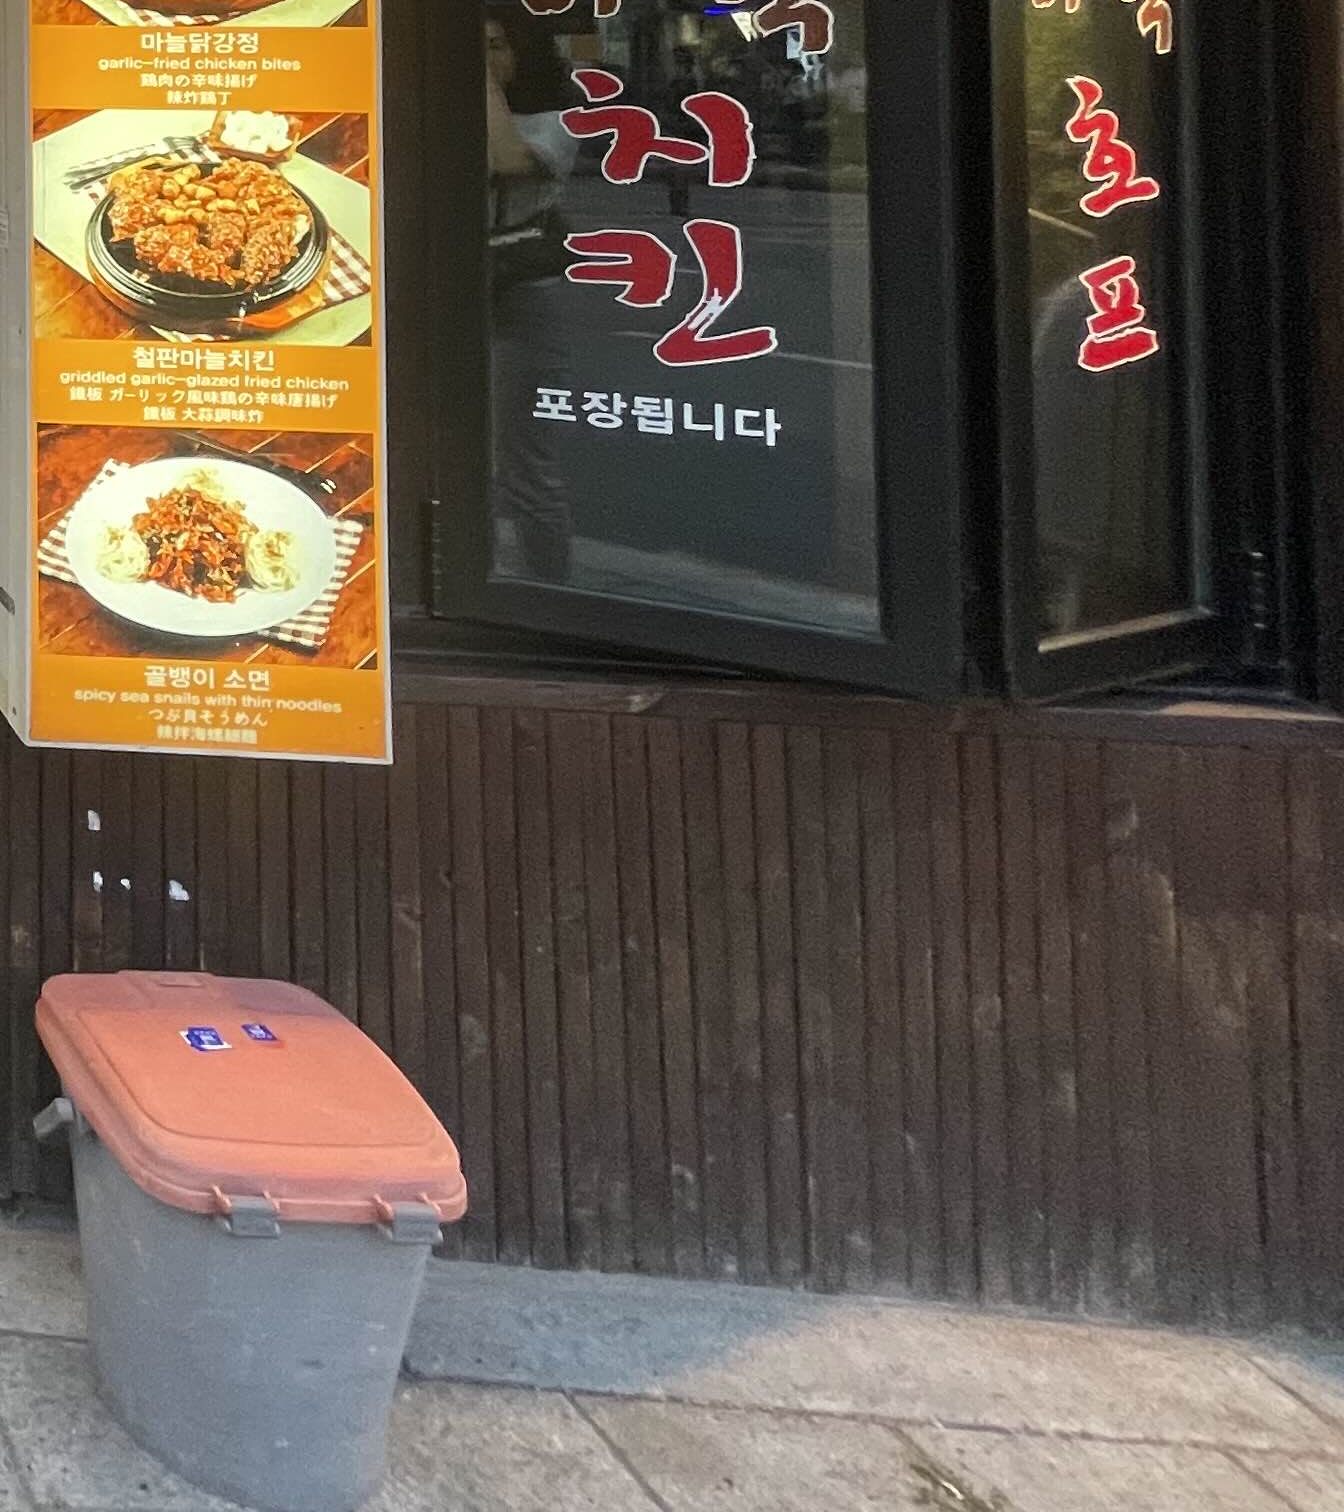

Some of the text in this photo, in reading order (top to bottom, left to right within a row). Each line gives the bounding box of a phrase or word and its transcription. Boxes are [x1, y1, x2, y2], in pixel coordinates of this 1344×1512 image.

[140, 31, 260, 54] 마늘닭강정
[194, 56, 257, 70] chicken
[261, 57, 302, 71] bites
[561, 68, 778, 367] 치킨
[1066, 75, 1160, 372] 호프
[132, 346, 275, 372] 철판마늘치킨
[59, 370, 127, 386] griddled
[244, 375, 281, 389] fried
[285, 376, 350, 391] chicken
[532, 386, 782, 447] 포장됩니다
[144, 664, 272, 692] 골뱅이 소면
[74, 688, 343, 714] spicy sea snails with thin noodles
